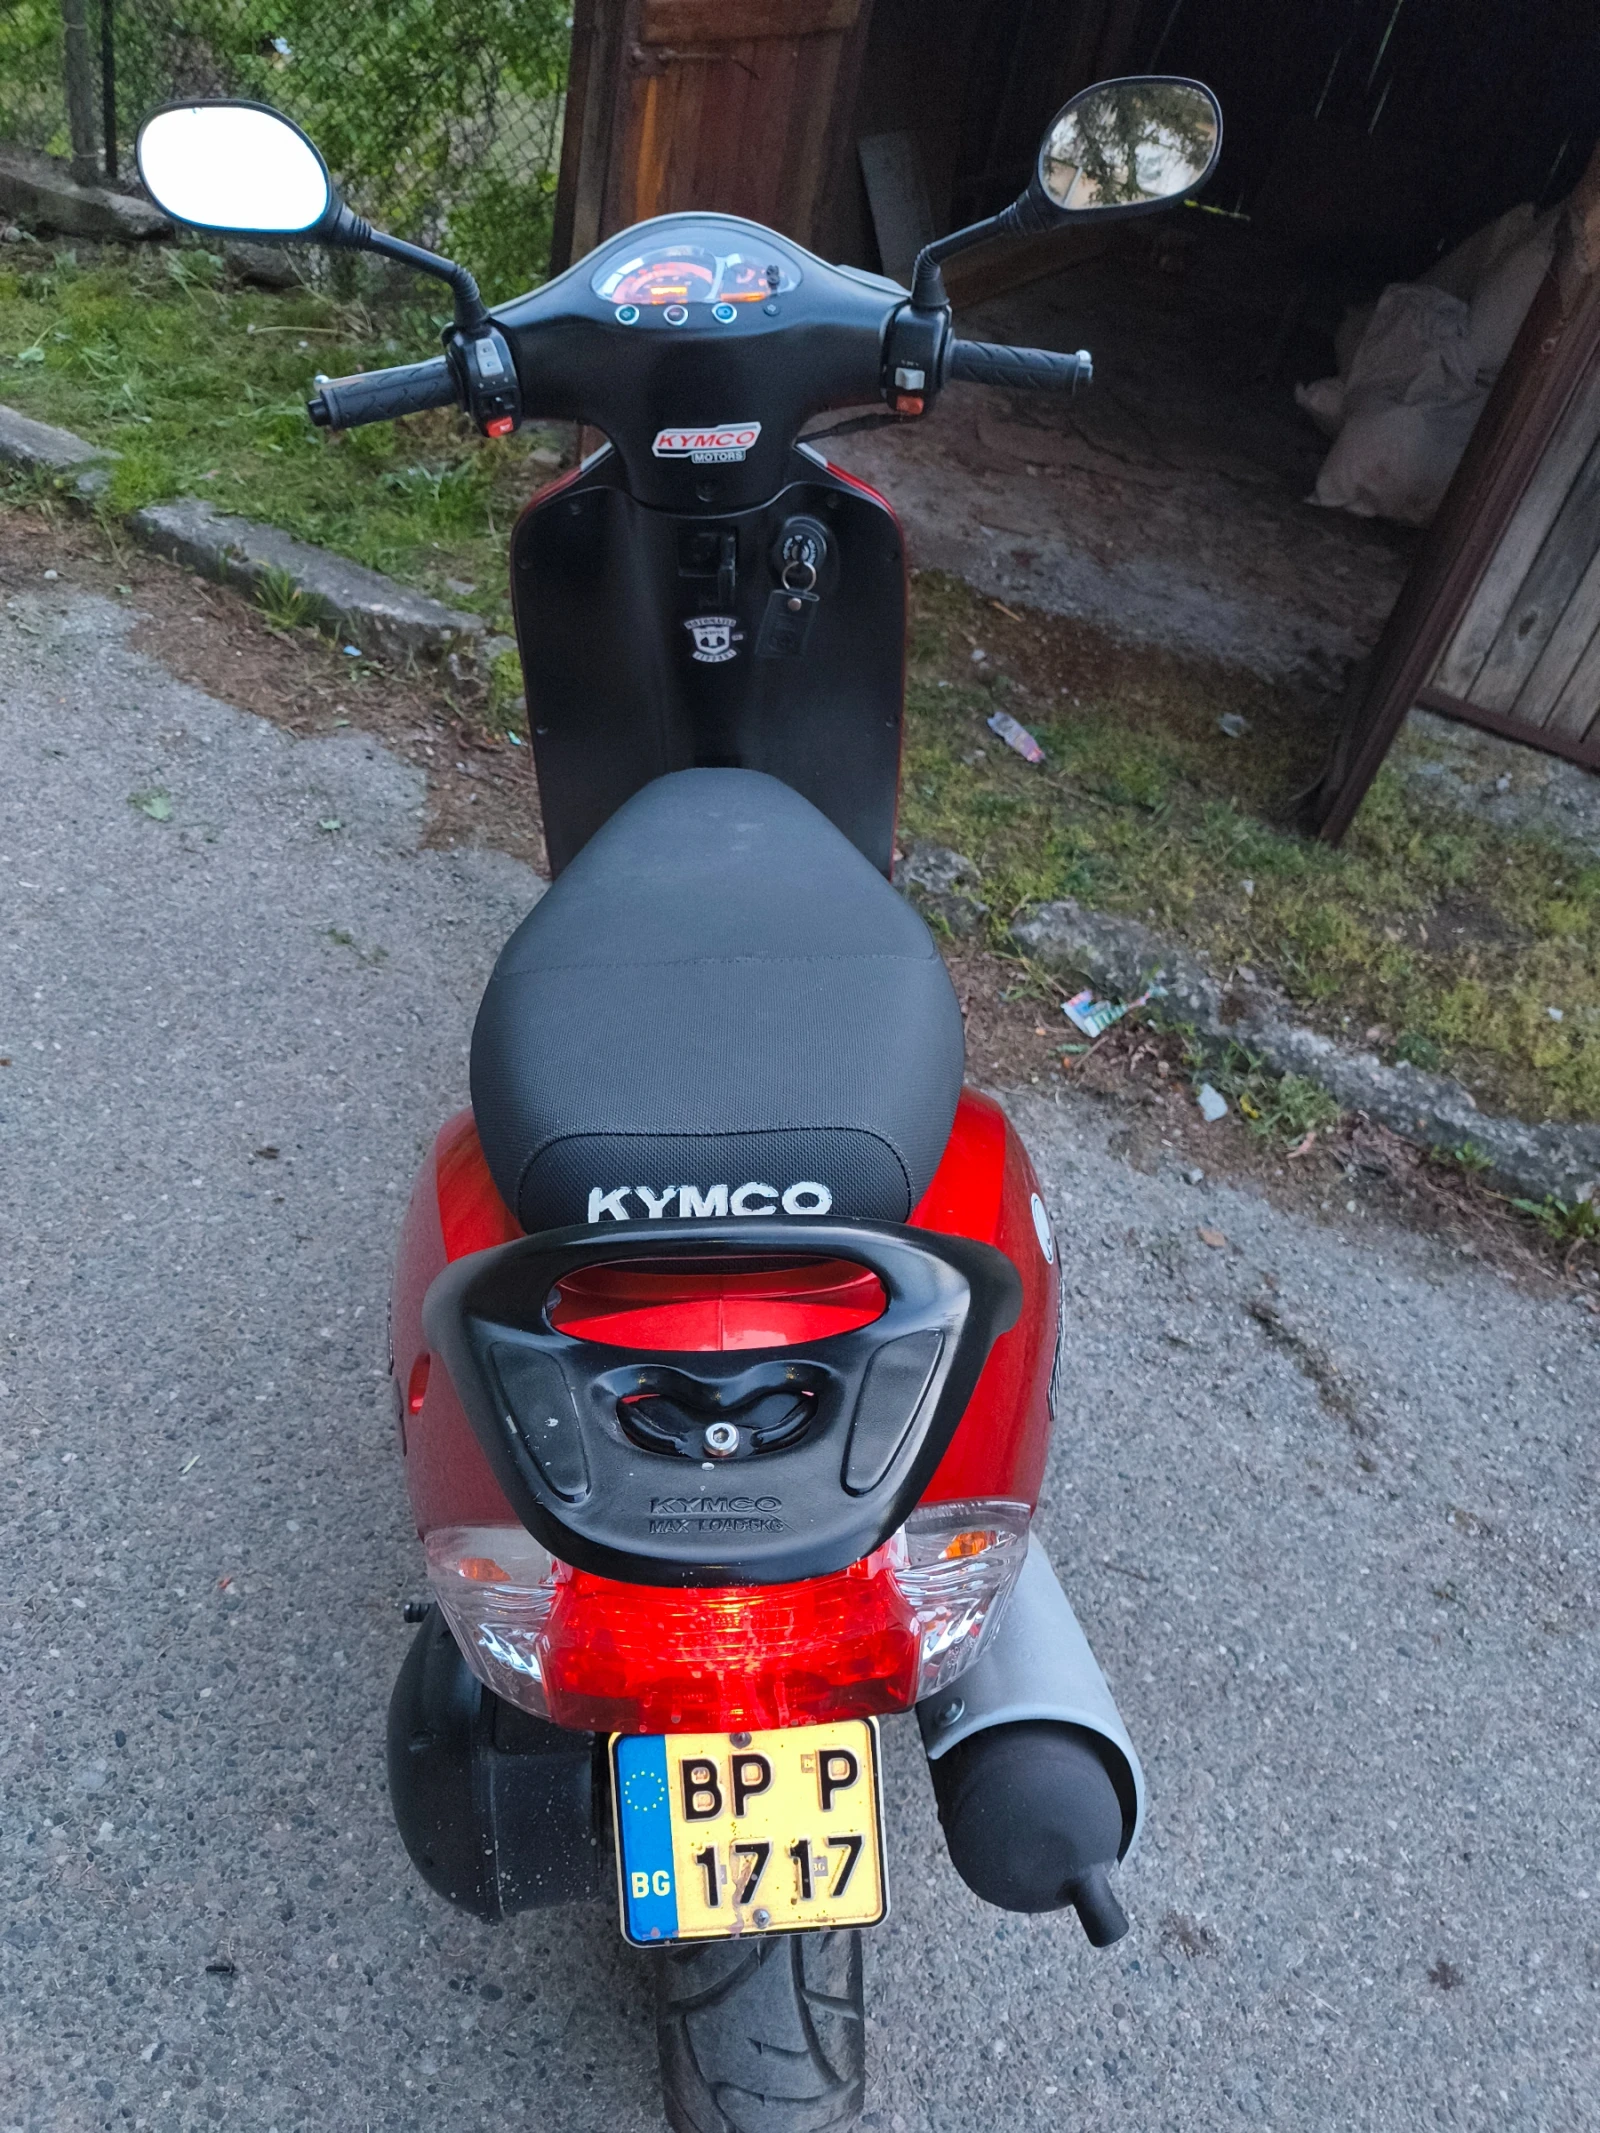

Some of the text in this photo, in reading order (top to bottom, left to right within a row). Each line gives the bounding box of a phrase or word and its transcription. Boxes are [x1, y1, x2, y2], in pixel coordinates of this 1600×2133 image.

[658, 431, 755, 447] KYMCO
[694, 452, 743, 462] MOTORS
[588, 1181, 832, 1223] KYMCO
[650, 1496, 782, 1514] KYMCO
[650, 1519, 689, 1533] MAX
[681, 1749, 859, 1820] BP P
[696, 1835, 863, 1907] 1717
[631, 1871, 670, 1898] BG
